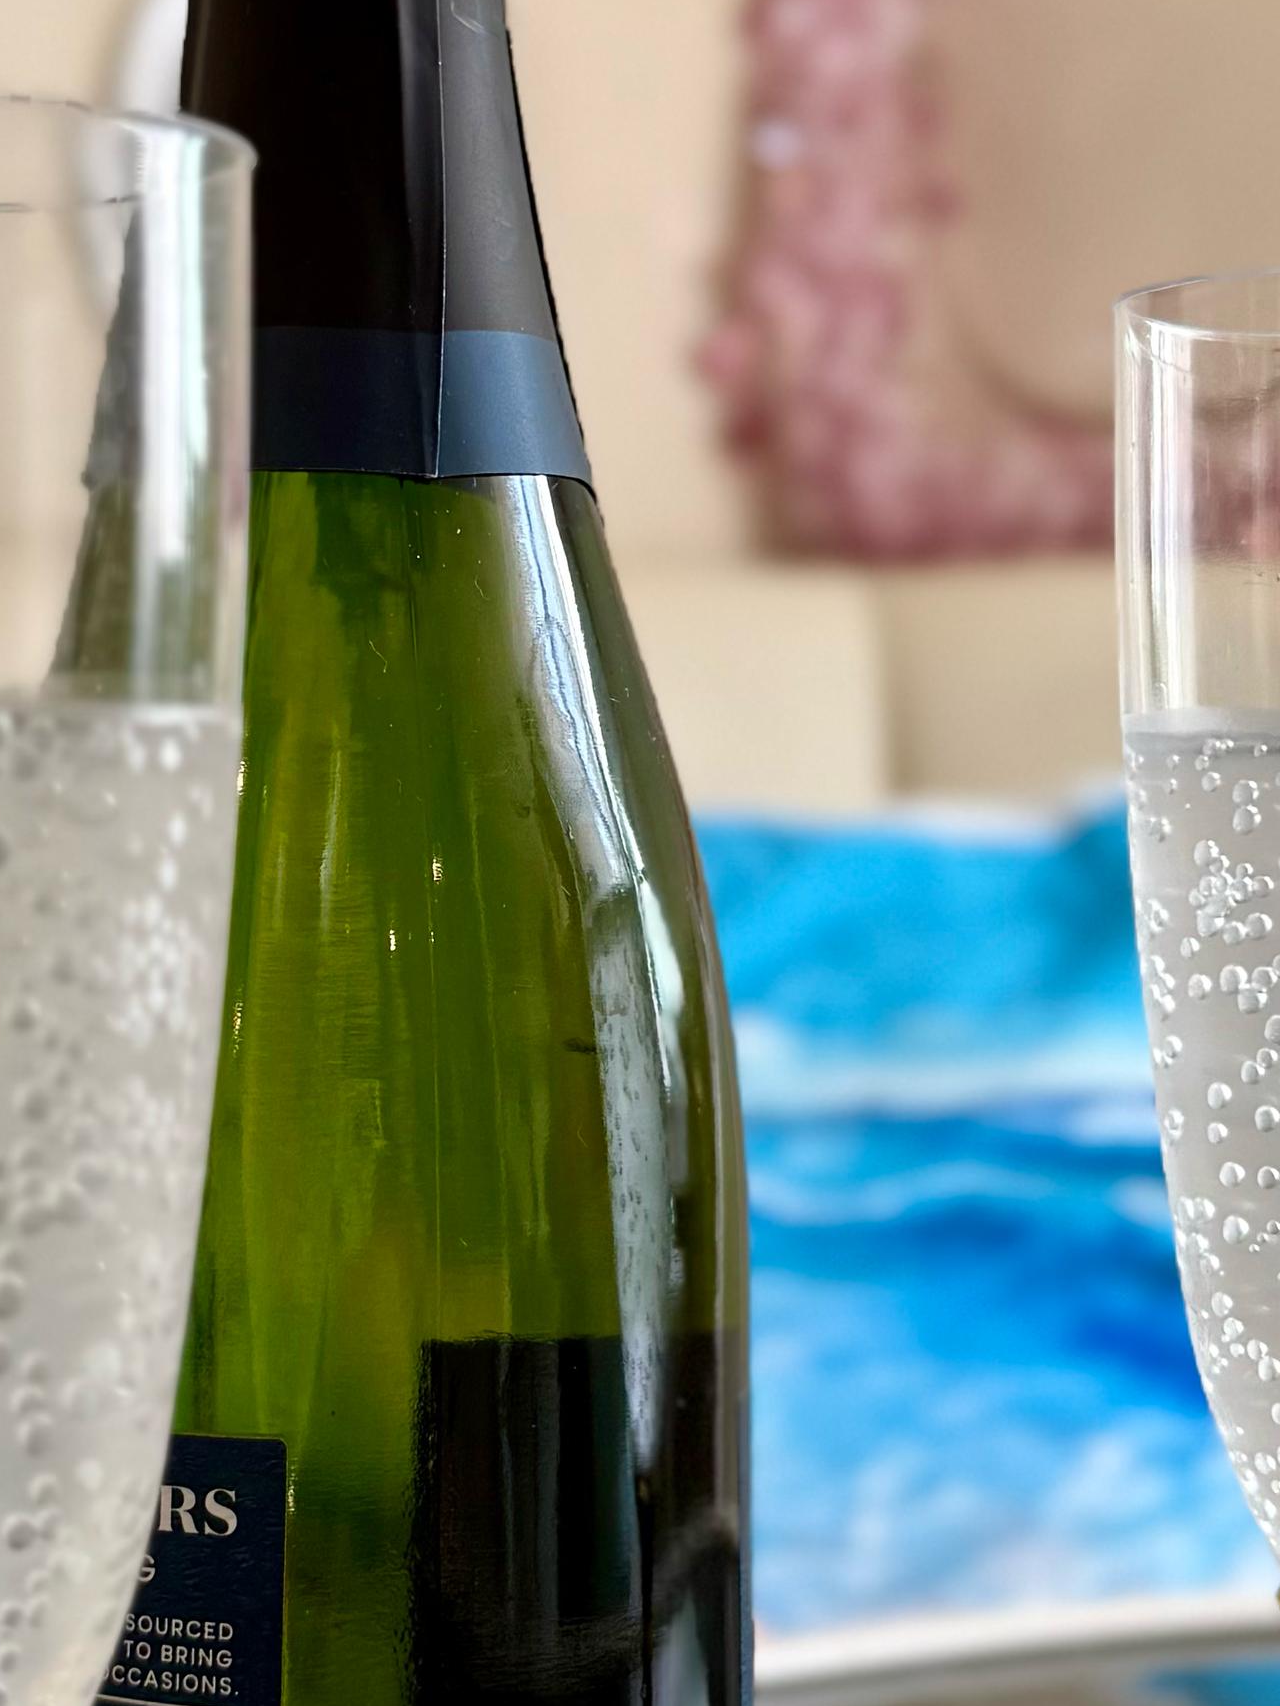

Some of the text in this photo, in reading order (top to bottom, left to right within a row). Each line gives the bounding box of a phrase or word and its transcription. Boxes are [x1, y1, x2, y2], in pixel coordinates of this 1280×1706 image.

[158, 1485, 238, 1537] RS
[125, 1613, 234, 1641] SOURCED
[124, 1640, 233, 1668] TO BRING
